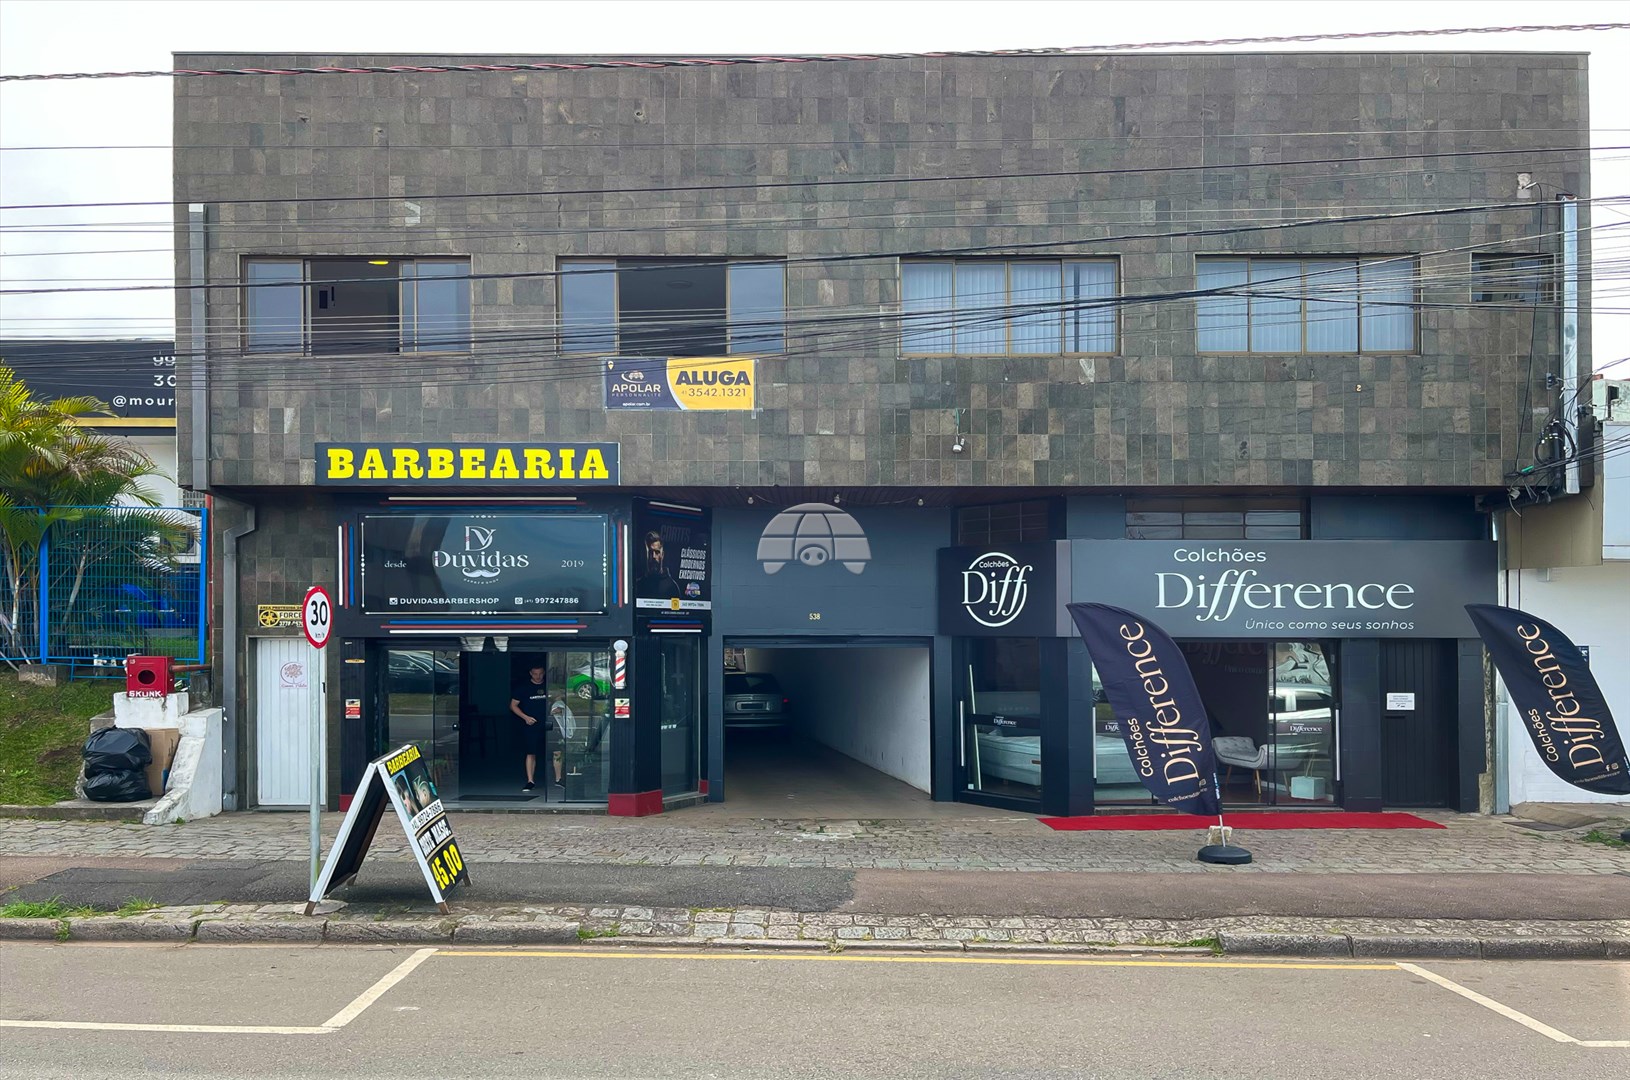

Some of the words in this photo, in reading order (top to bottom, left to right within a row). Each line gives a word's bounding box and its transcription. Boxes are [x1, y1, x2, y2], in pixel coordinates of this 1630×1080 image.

[612, 383, 661, 393] APOLAR
[676, 371, 751, 386] ALUGA
[688, 388, 746, 397] 3542.1321
[327, 448, 609, 479] BARBEARIA
[384, 560, 407, 569] desde
[561, 559, 585, 568] 2019
[1173, 548, 1267, 562] Colchões
[400, 597, 500, 605] DUVIDASBARBERSHOP
[961, 565, 1033, 616] Diff
[1155, 569, 1415, 621] Difference
[310, 600, 328, 626] 30
[1245, 618, 1285, 630] Único
[1288, 621, 1328, 630] como
[1331, 621, 1362, 630] seus
[1365, 620, 1415, 630] sonhos
[128, 690, 162, 698] SKUNK
[1119, 621, 1203, 786] Difference
[1516, 623, 1605, 770] Difference
[1127, 717, 1154, 778] Colchões
[1528, 707, 1560, 763] Colchões
[386, 745, 421, 775] BARBEARIA
[431, 843, 463, 890] 45,00
